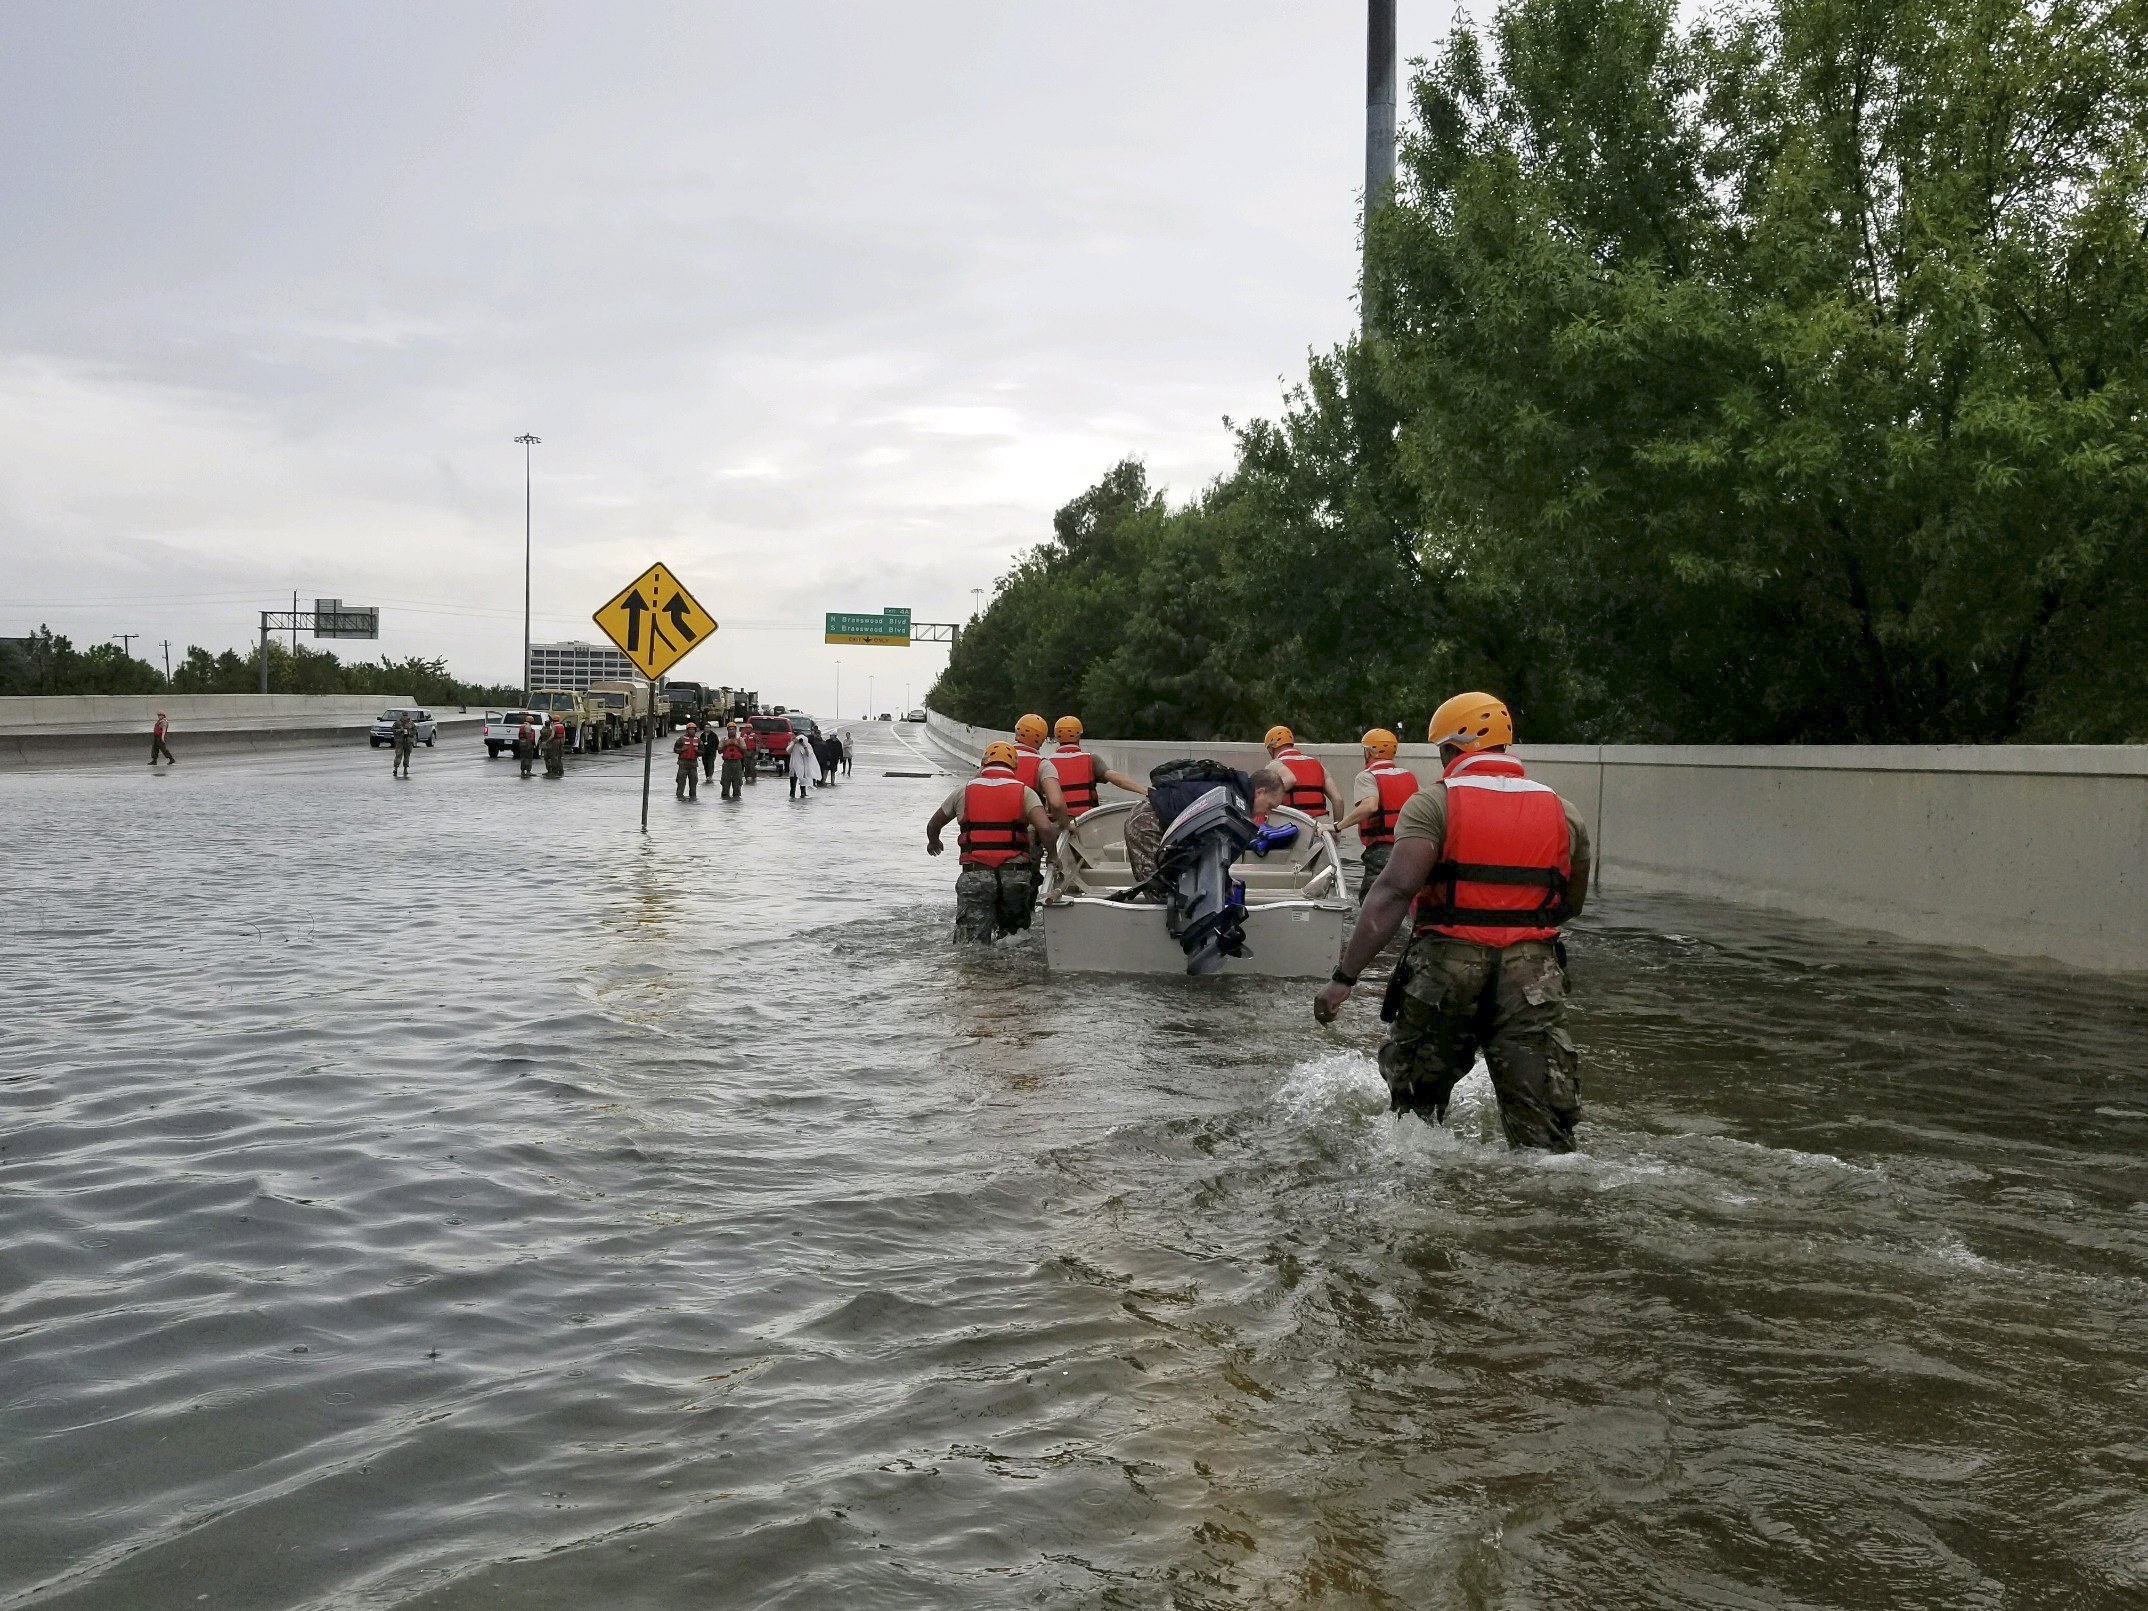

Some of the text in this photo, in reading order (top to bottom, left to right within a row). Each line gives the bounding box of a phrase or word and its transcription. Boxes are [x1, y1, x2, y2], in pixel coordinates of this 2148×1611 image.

[842, 616, 883, 624] Braeswood
[841, 625, 883, 633] Braeswood
[888, 626, 906, 634] Blvd
